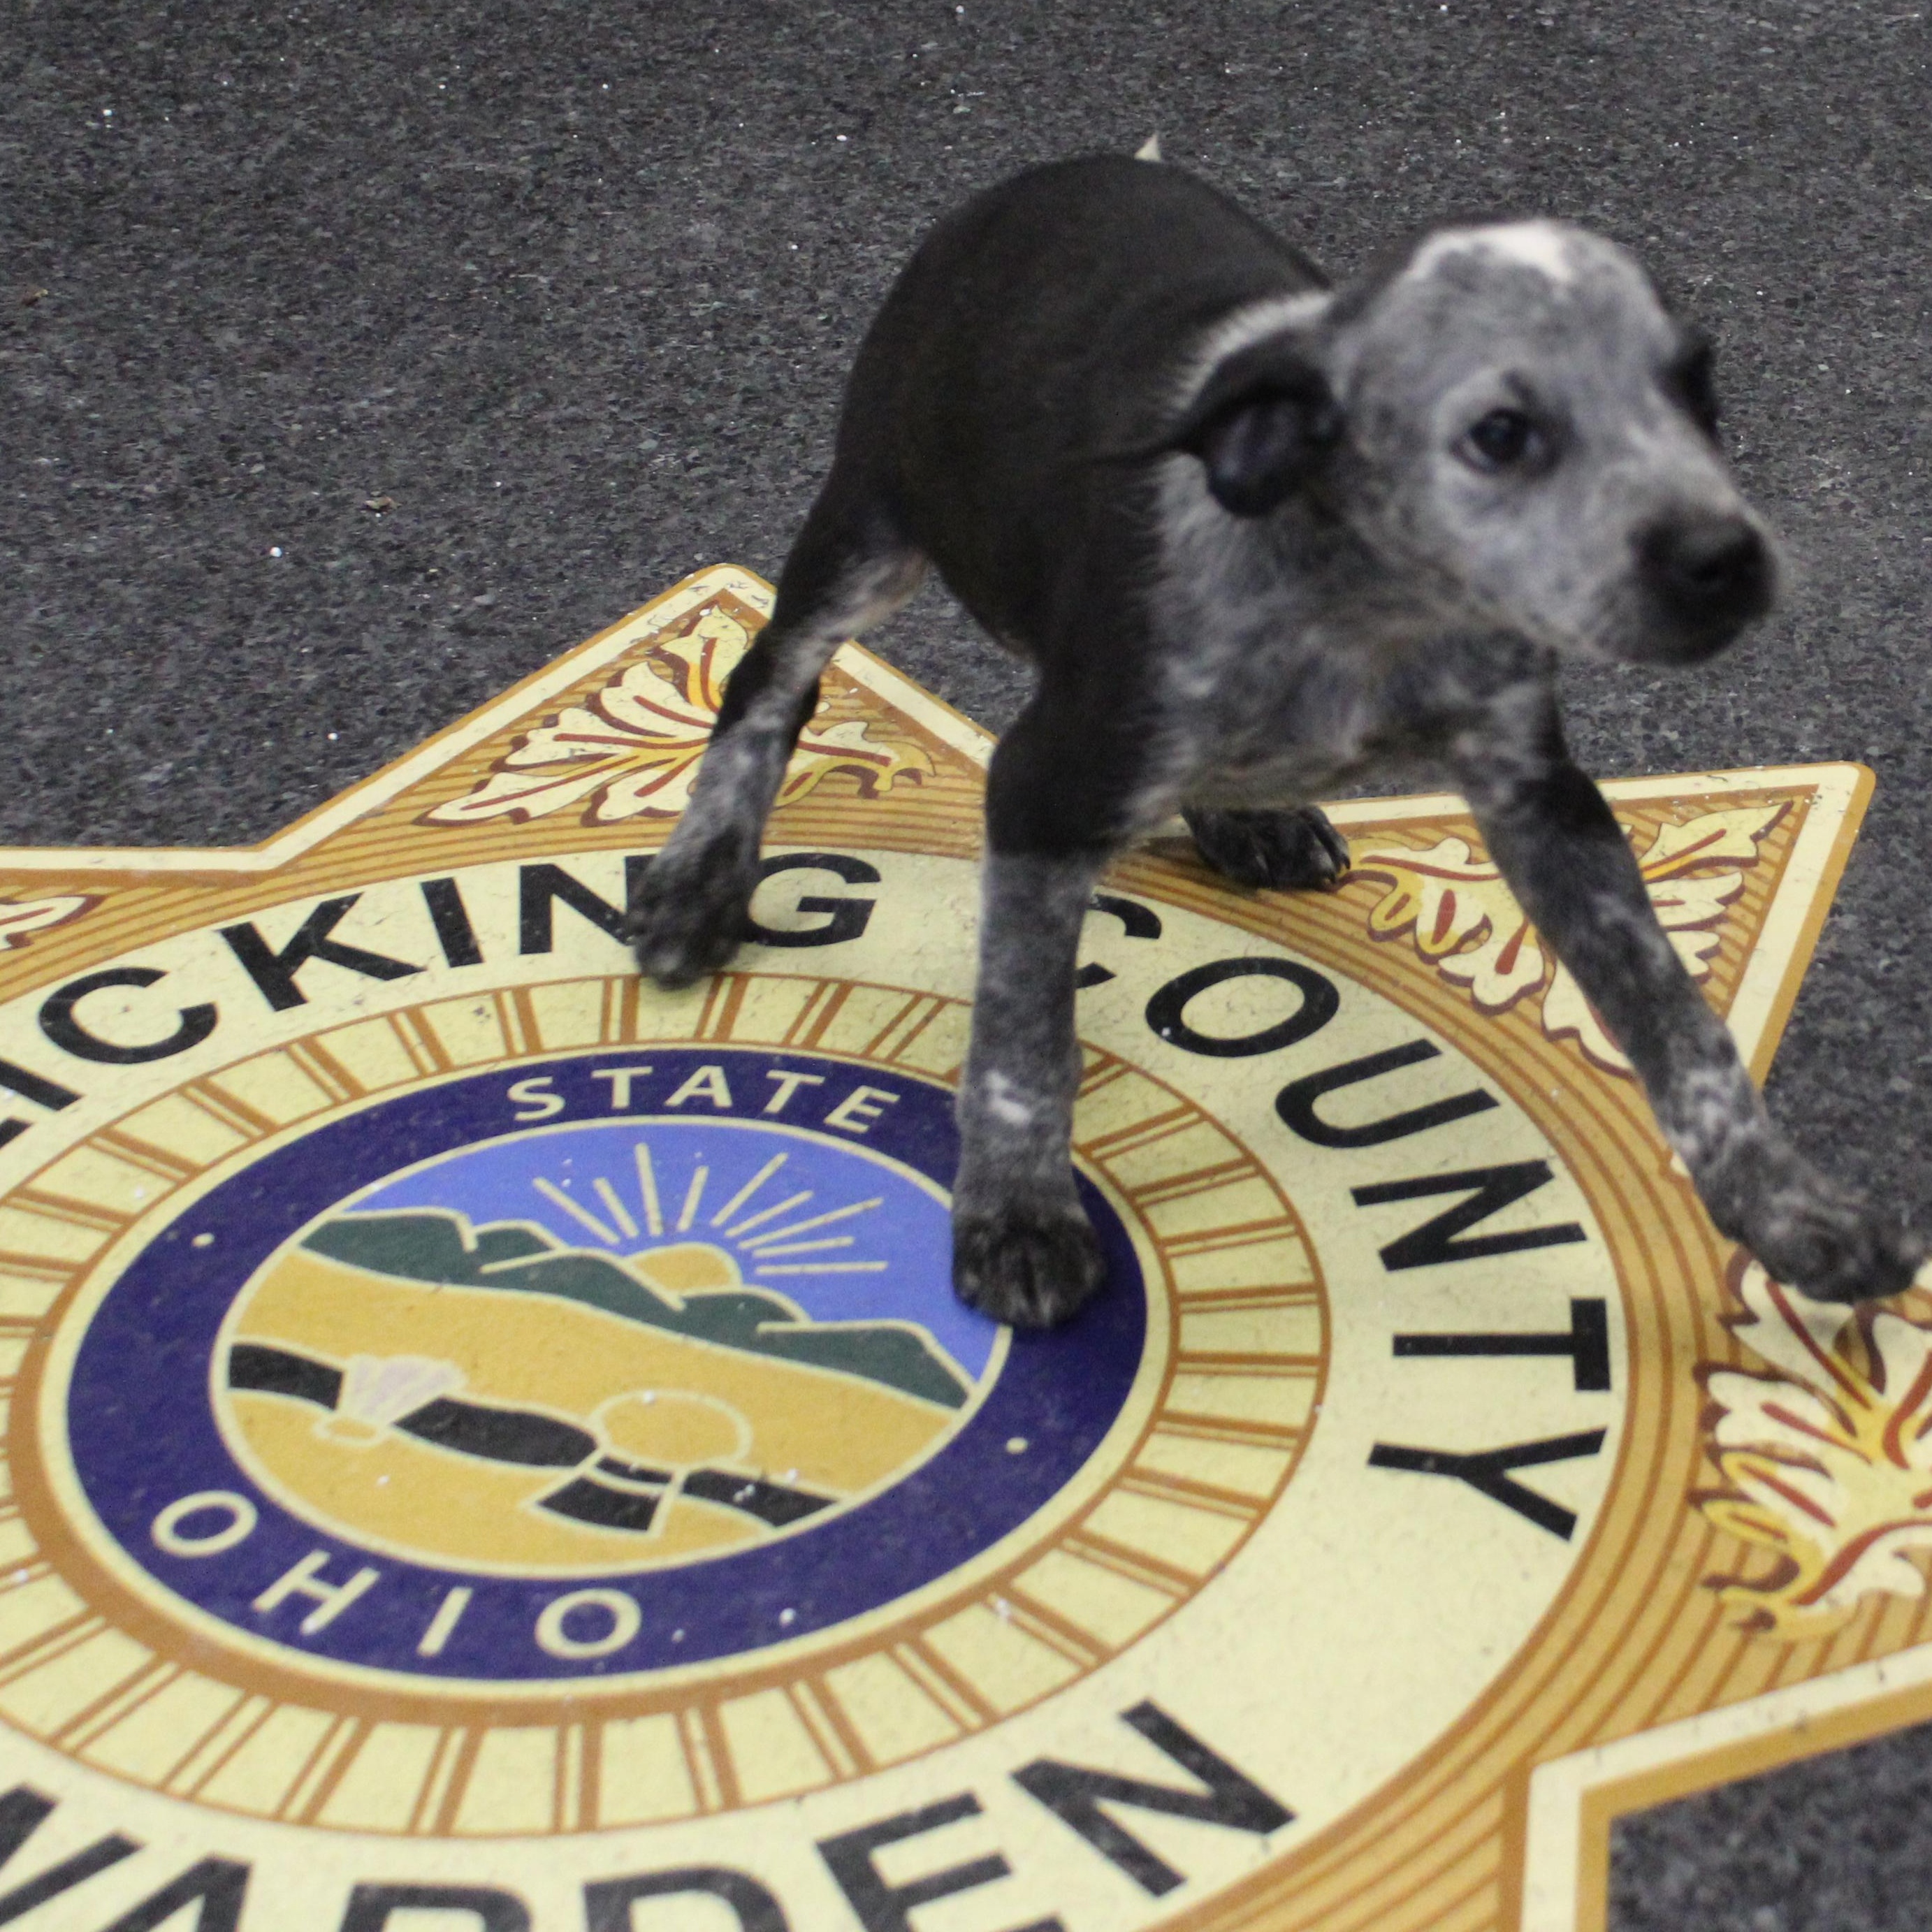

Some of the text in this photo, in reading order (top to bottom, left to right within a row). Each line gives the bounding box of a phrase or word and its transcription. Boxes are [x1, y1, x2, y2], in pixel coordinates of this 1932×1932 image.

[0, 852, 881, 1147] ICKING
[507, 1065, 901, 1133] STATE
[151, 1490, 641, 1659] OHIO
